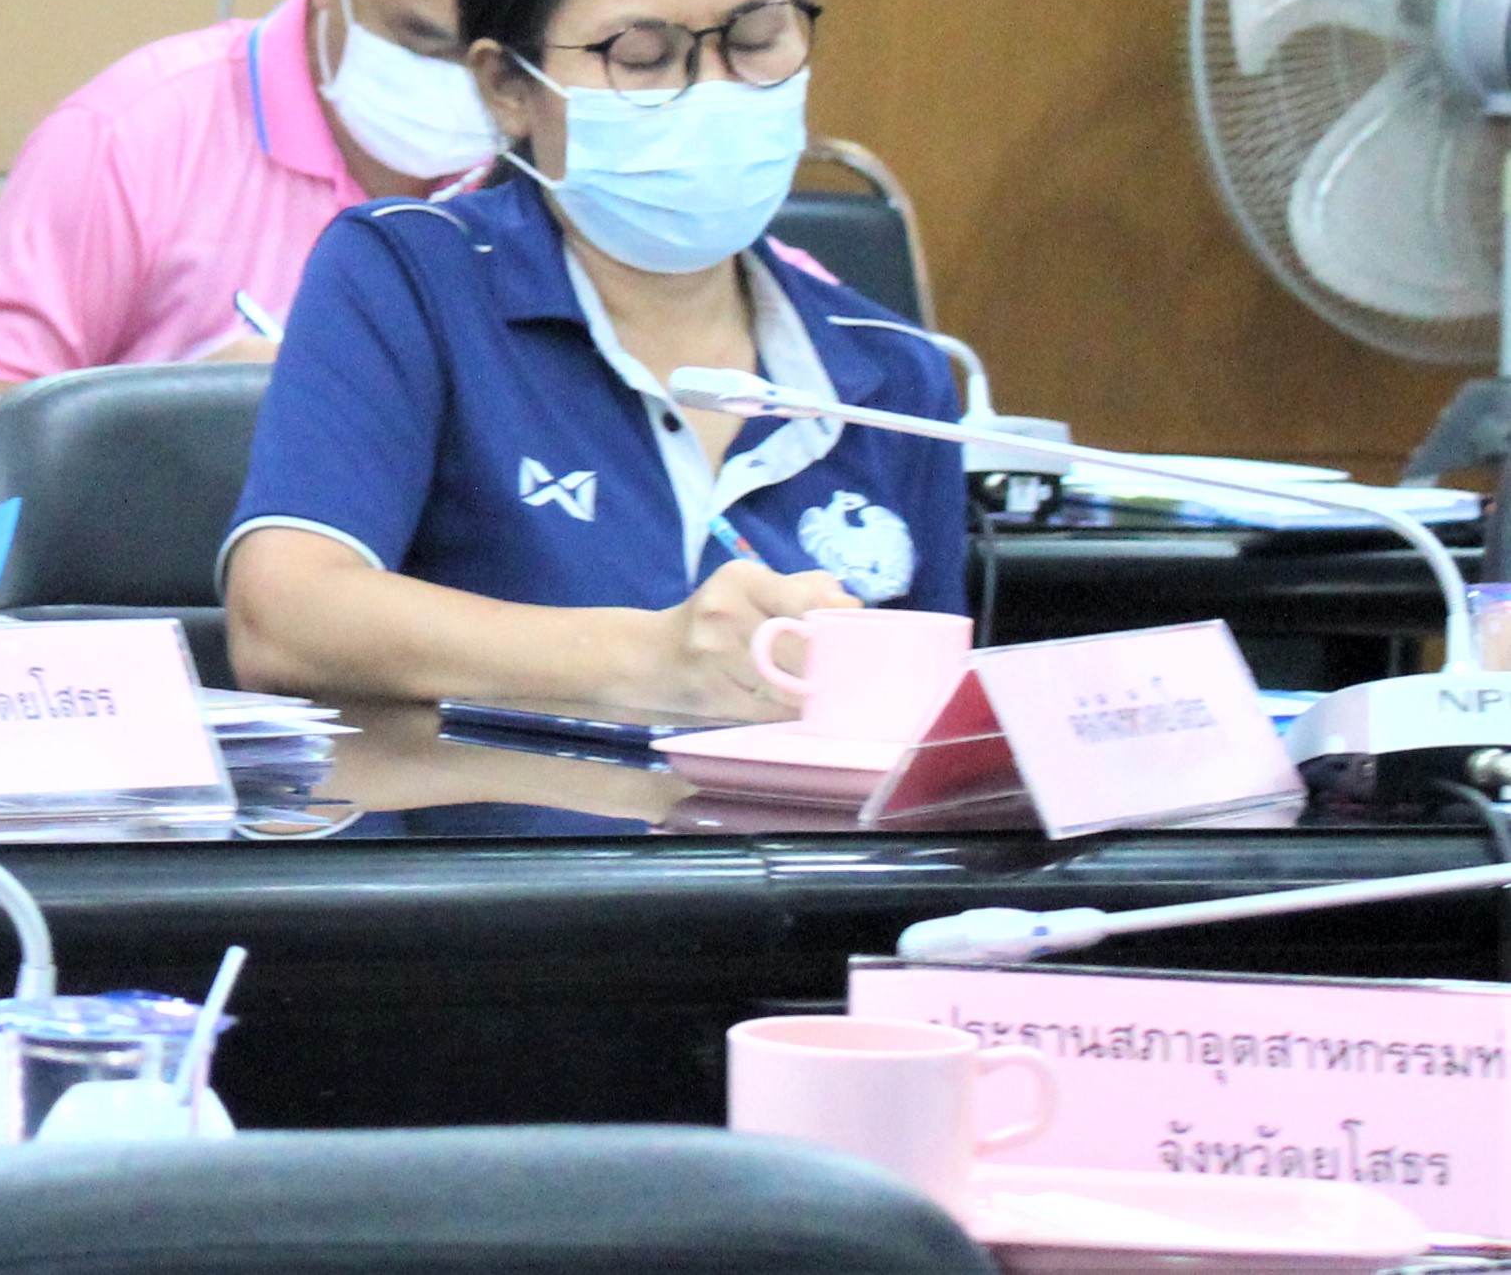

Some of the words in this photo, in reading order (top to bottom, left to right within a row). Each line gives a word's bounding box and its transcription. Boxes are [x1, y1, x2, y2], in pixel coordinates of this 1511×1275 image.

[1438, 689, 1511, 713] NP
[1157, 1119, 1451, 1186] จังหวัดยโสธร
